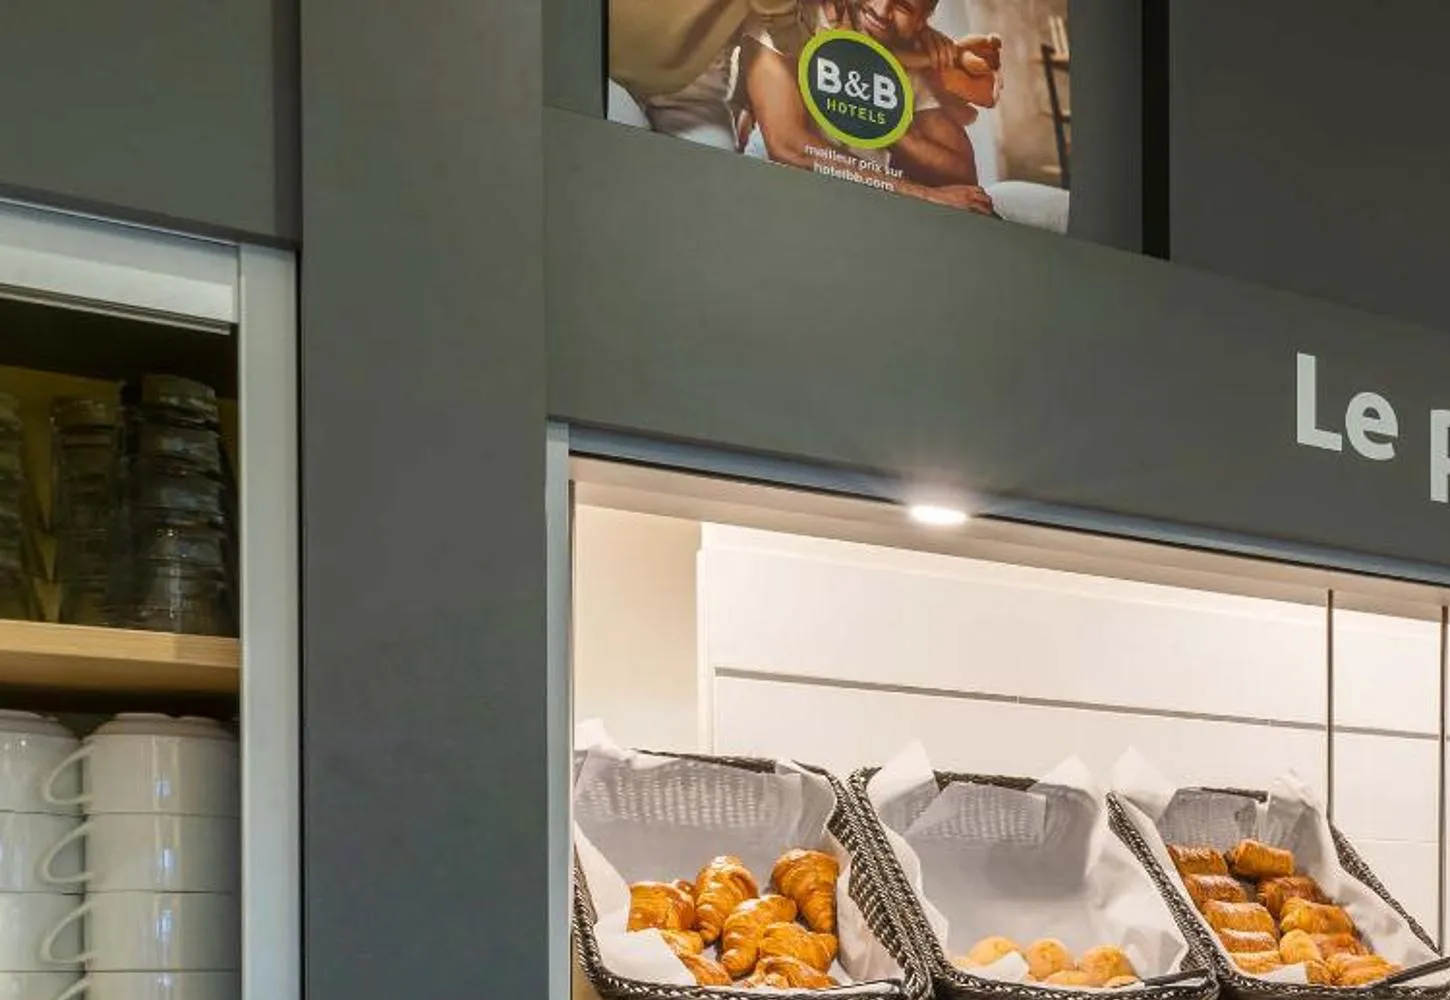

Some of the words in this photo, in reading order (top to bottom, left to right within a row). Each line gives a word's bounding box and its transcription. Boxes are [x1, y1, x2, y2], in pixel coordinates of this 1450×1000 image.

[817, 57, 898, 109] B&B
[827, 98, 886, 124] HOTELS
[804, 144, 857, 166] meilleur
[813, 161, 896, 192] hotelbb.com
[1297, 352, 1398, 461] Le
